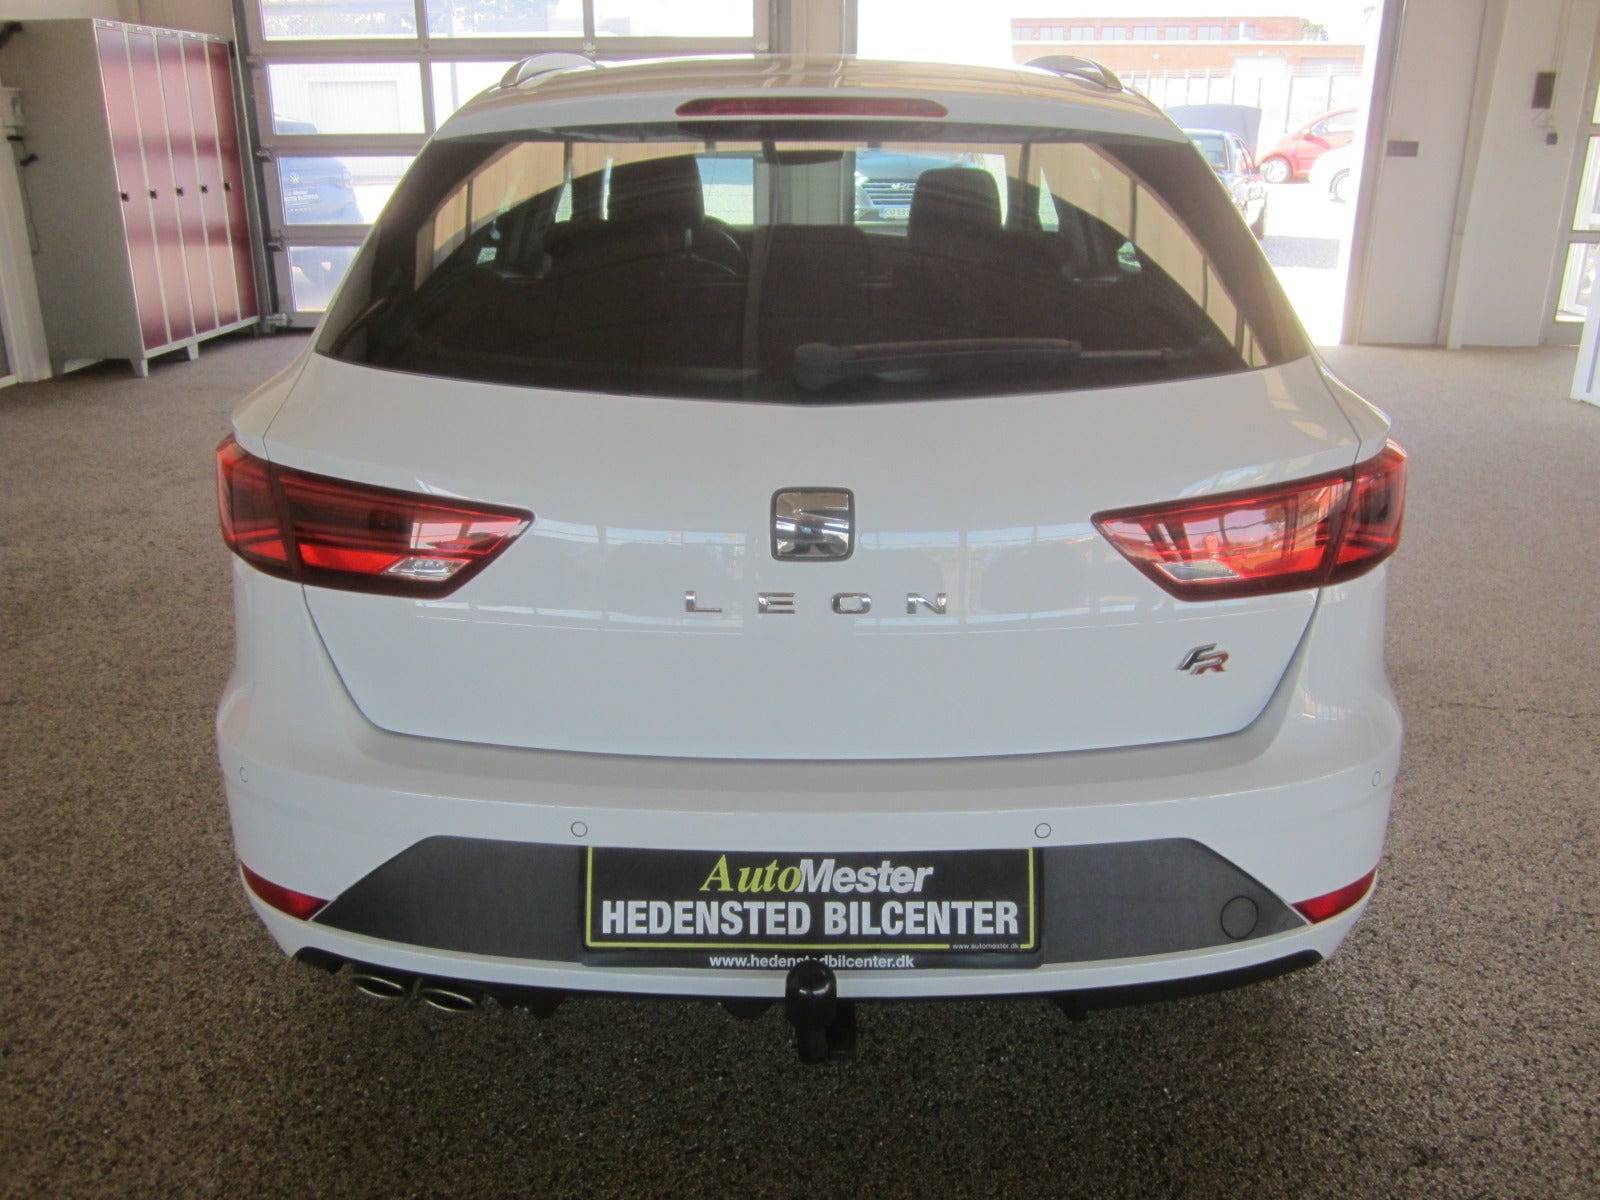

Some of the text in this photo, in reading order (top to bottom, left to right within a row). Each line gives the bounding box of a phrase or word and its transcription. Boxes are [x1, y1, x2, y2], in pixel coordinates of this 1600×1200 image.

[684, 590, 947, 615] LEON
[1176, 643, 1229, 675] FR
[699, 854, 935, 894] AutoMester
[601, 900, 1019, 936] HEDENSTED BILCENTER
